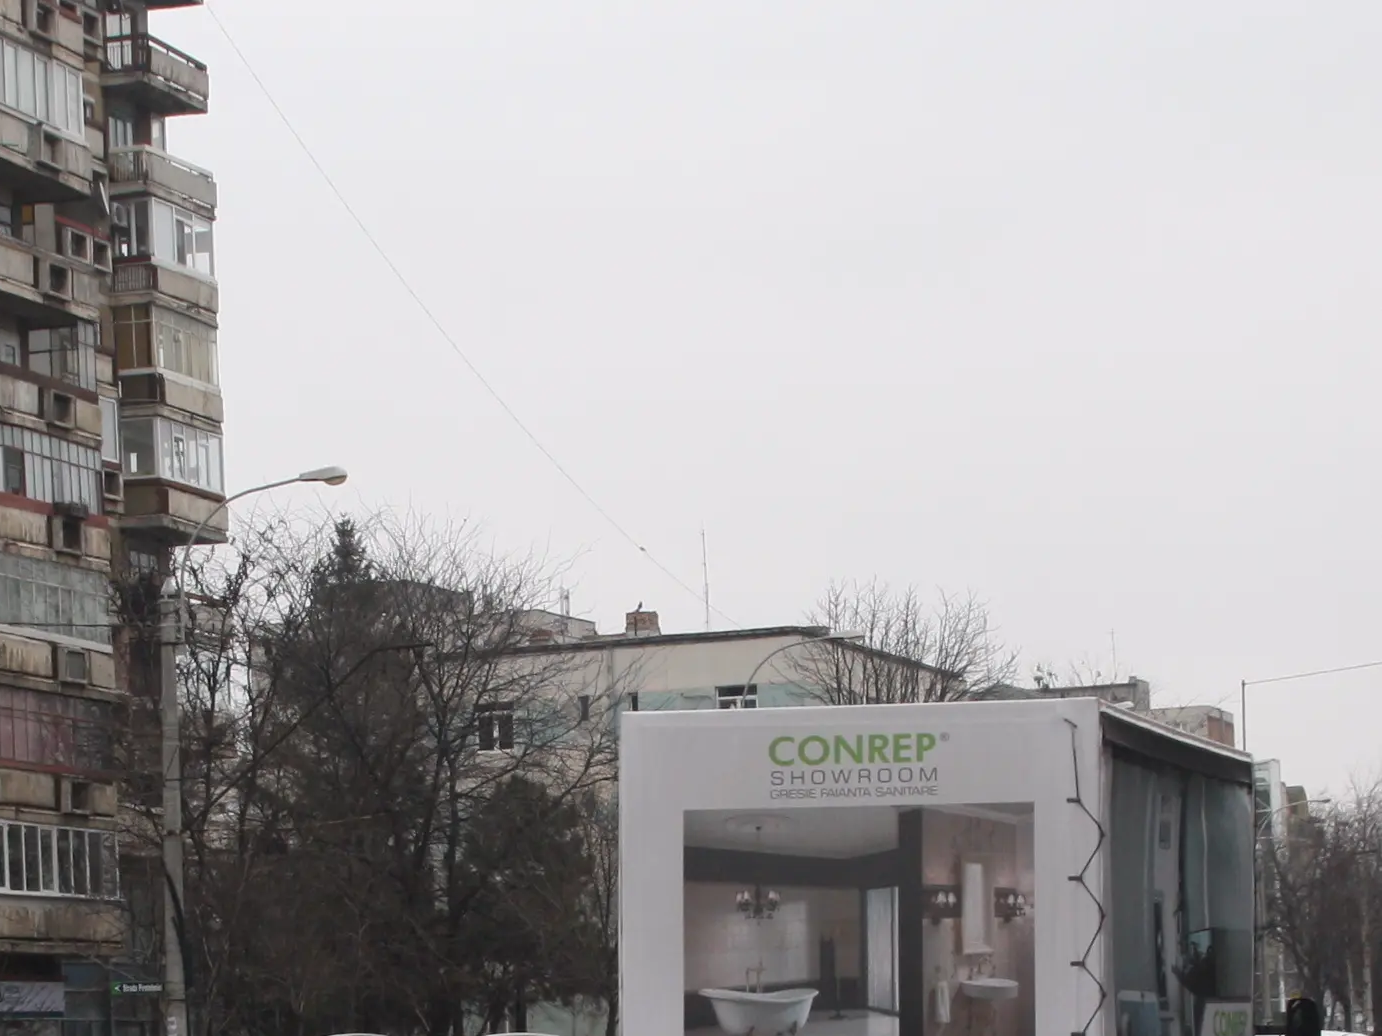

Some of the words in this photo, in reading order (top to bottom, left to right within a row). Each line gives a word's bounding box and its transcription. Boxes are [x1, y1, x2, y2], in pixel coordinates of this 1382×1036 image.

[768, 732, 937, 767] CONREP
[770, 767, 938, 786] SHOWROOM
[770, 788, 817, 800] GRESIE
[875, 785, 939, 798] SANITARE
